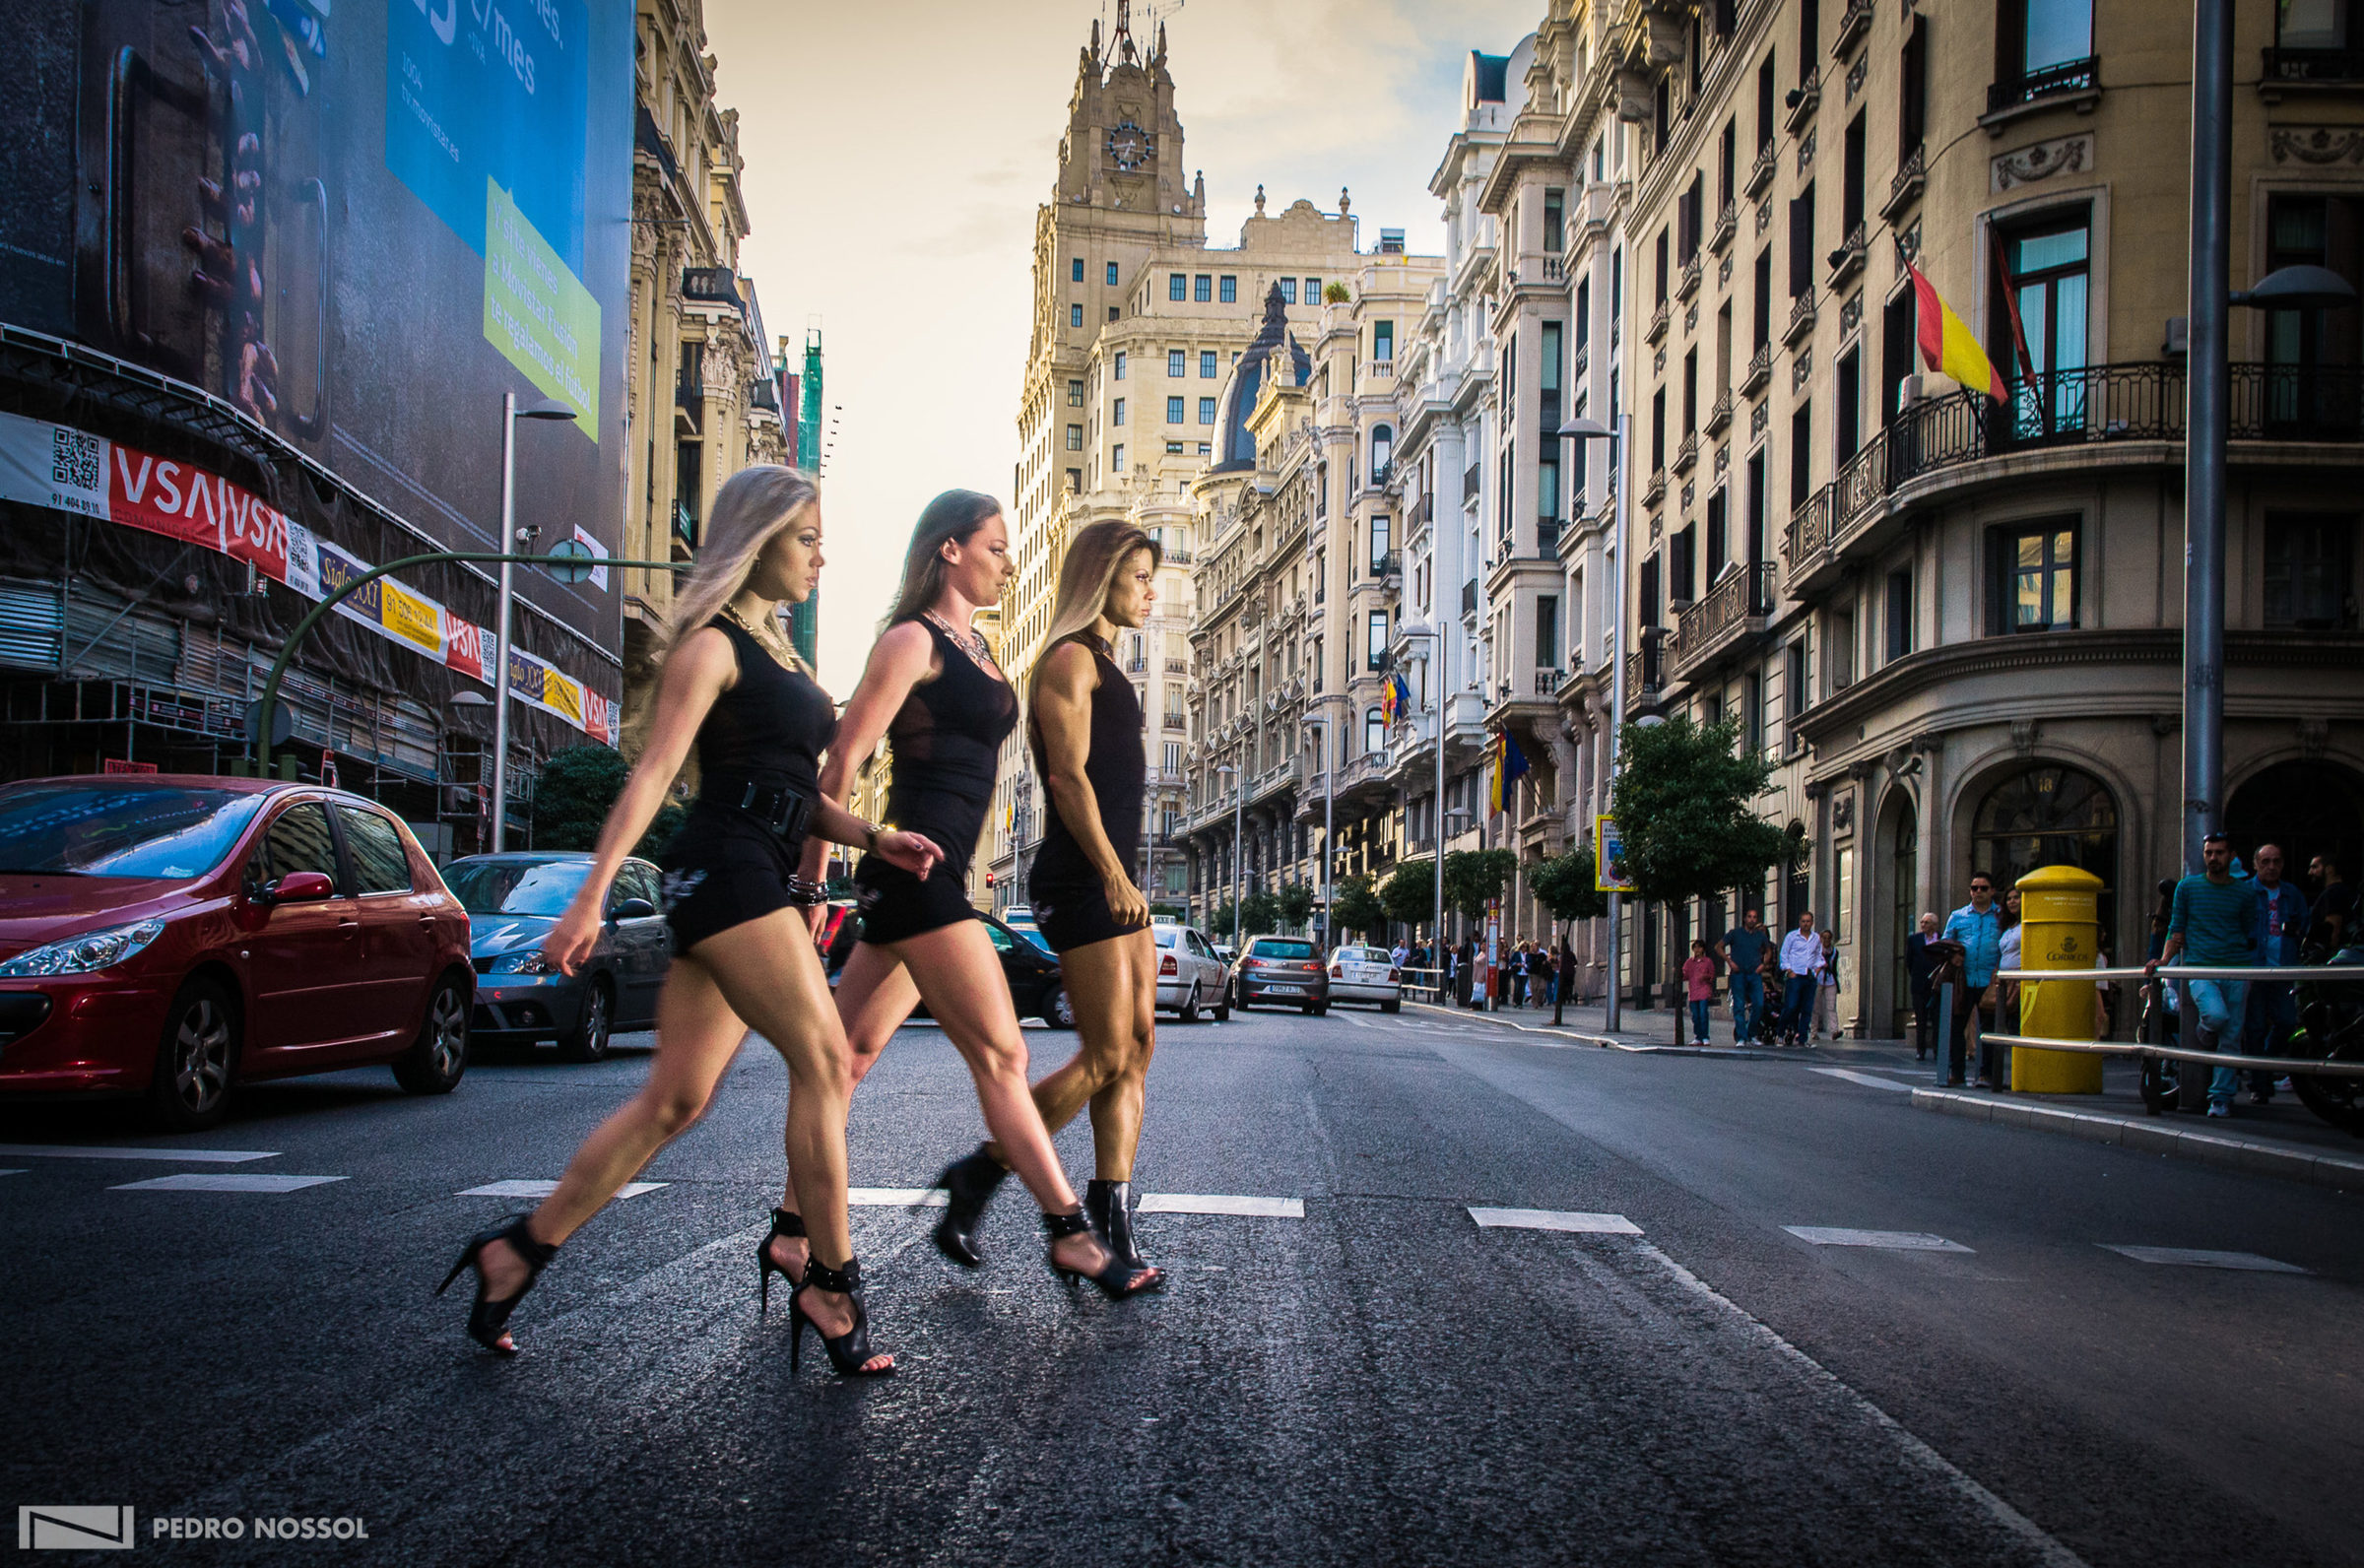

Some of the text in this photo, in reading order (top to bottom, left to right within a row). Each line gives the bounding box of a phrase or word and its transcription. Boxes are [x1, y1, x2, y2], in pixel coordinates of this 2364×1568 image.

[493, 199, 558, 295] Y si te vienes
[493, 253, 578, 359] a Movistar Fusión
[491, 294, 502, 325] te
[503, 307, 555, 376] regalamos
[556, 359, 564, 387] el
[51, 492, 62, 505] 91
[65, 495, 80, 509] 404
[386, 593, 396, 615] 91
[508, 656, 525, 686] iglo
